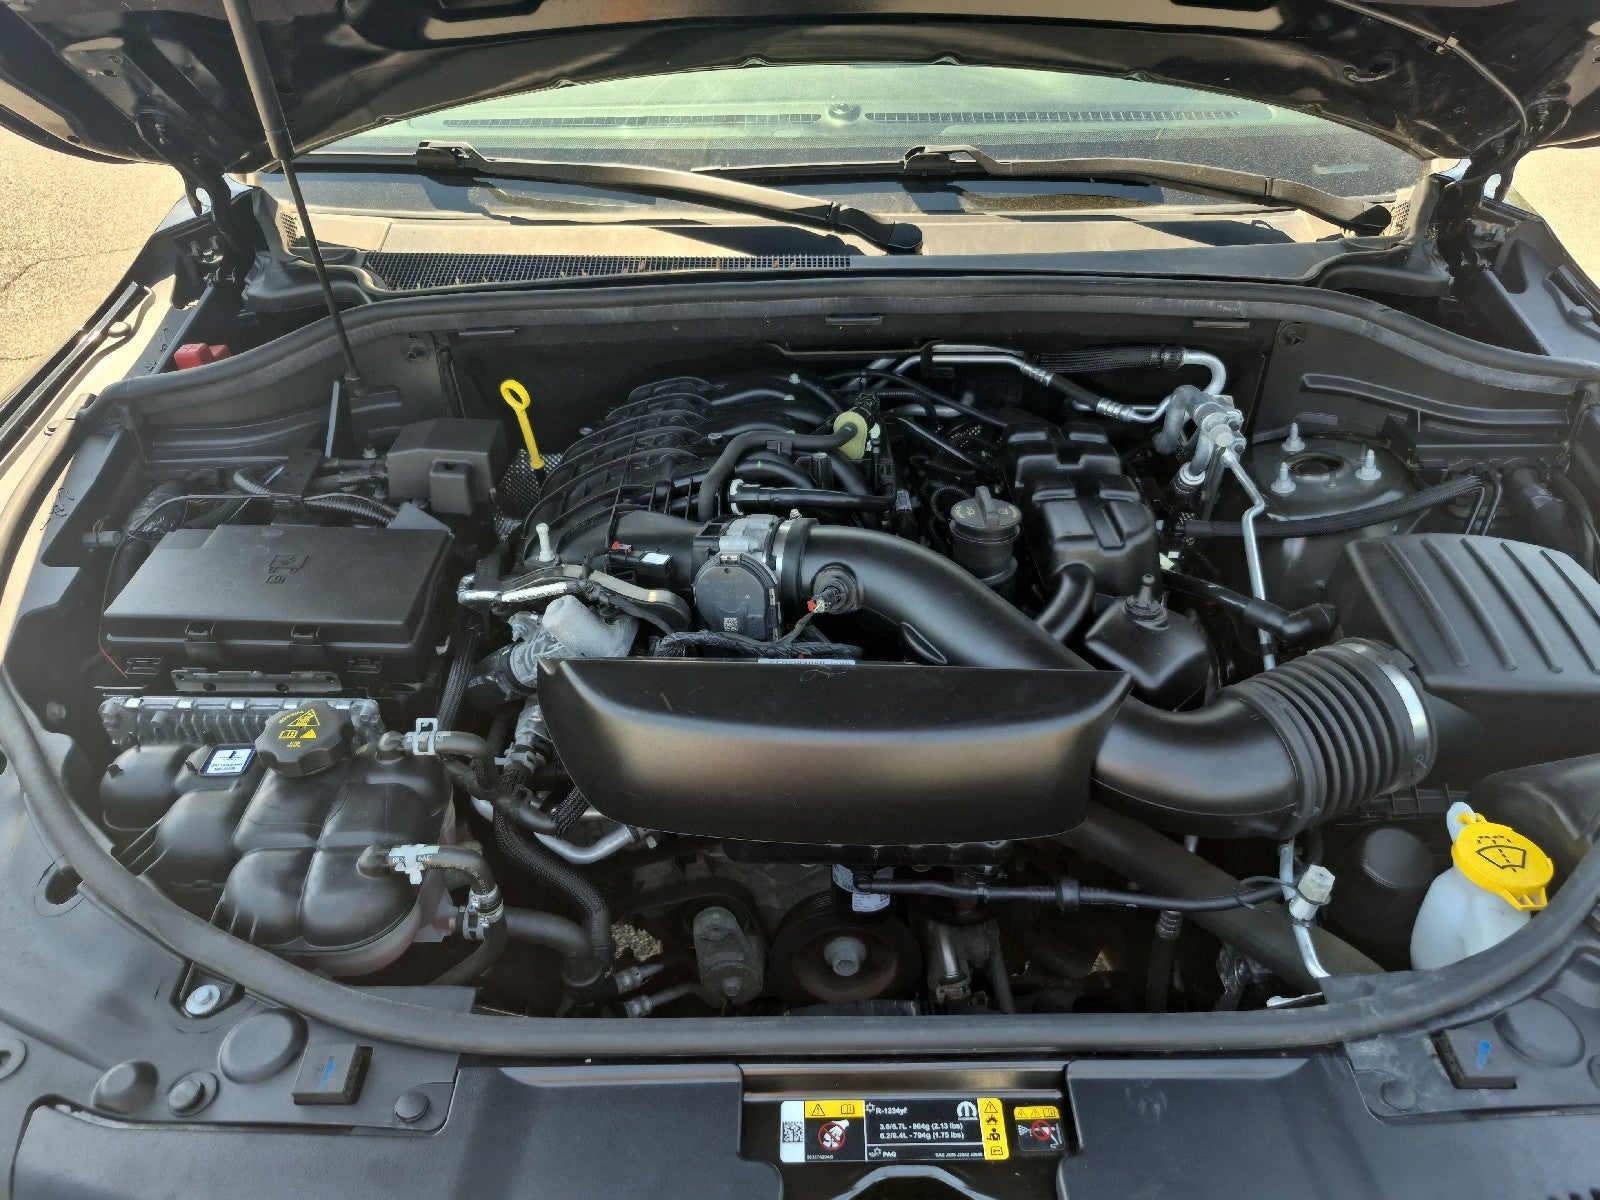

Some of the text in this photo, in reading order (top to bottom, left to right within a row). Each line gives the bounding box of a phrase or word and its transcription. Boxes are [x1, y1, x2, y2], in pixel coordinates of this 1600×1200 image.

[875, 1106, 908, 1116] R-1234yf
[931, 1122, 949, 1131] (2.13
[949, 1121, 963, 1131] lbs)
[932, 1131, 950, 1140] (1.75
[950, 1131, 965, 1140] lbs)
[882, 1150, 897, 1158] PAG
